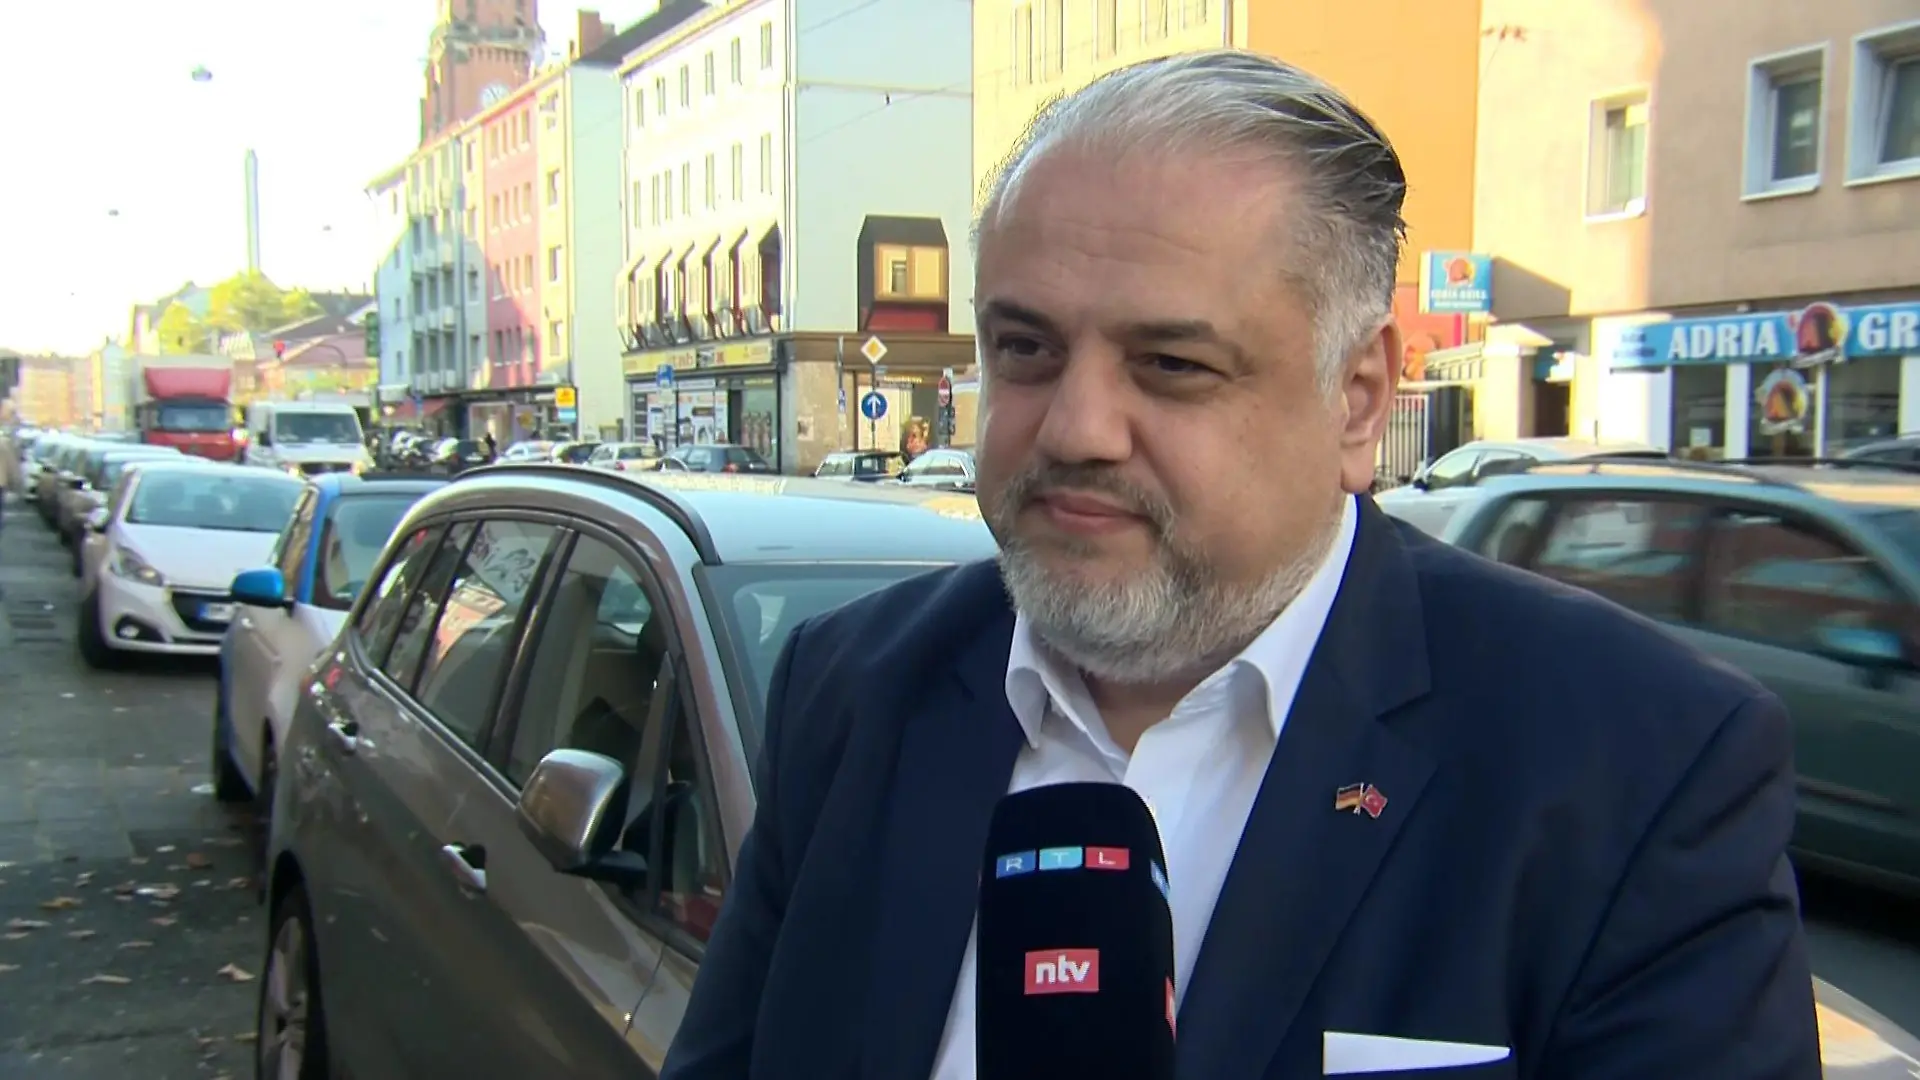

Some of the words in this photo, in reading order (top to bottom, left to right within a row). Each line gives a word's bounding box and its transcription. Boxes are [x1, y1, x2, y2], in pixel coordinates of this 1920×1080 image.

[1668, 320, 1779, 359] ADRIA
[1858, 311, 1919, 350] GR
[1006, 851, 1116, 872] RTL
[1036, 954, 1090, 984] ntv
